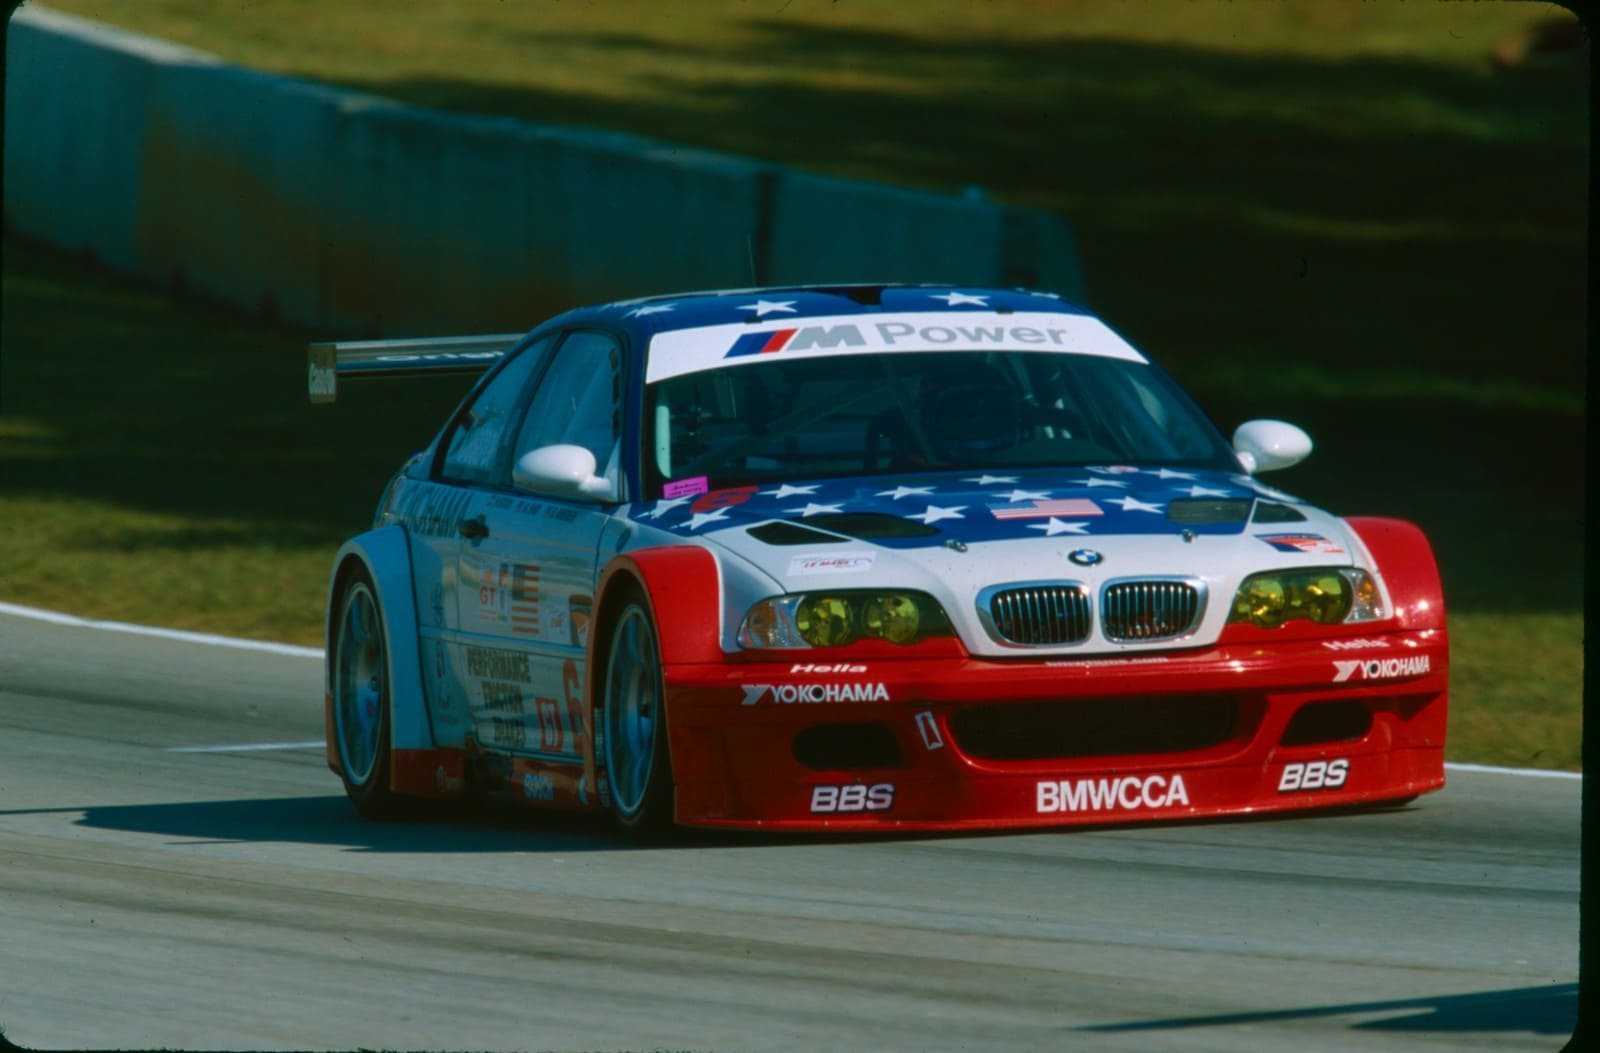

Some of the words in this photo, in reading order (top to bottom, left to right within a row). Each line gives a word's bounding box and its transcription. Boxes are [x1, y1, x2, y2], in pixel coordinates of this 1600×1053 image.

[785, 325, 867, 351] M
[875, 320, 1068, 347] Power
[480, 586, 496, 606] GT
[790, 664, 868, 675] Hella
[1361, 655, 1431, 680] YOKOHAMA
[771, 682, 891, 704] YOKOHAMA
[1278, 758, 1350, 793] BBS
[809, 783, 895, 813] BBS
[1036, 774, 1190, 814] BMWCCA
